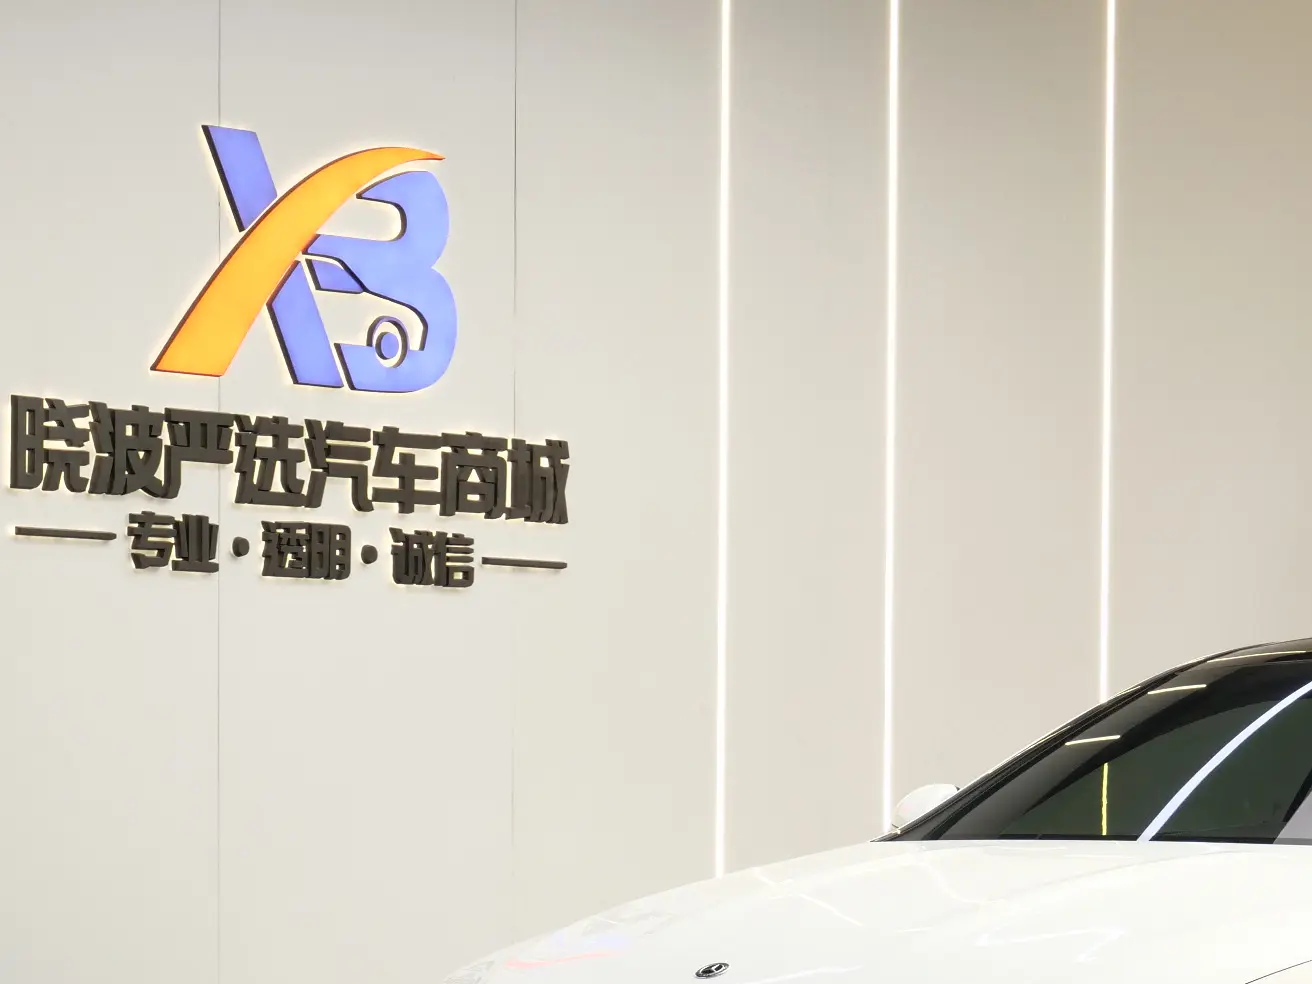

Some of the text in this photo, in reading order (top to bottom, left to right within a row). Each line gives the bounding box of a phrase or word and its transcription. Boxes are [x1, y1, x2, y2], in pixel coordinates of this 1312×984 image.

[9, 394, 570, 524] 晓波严选汽车商城
